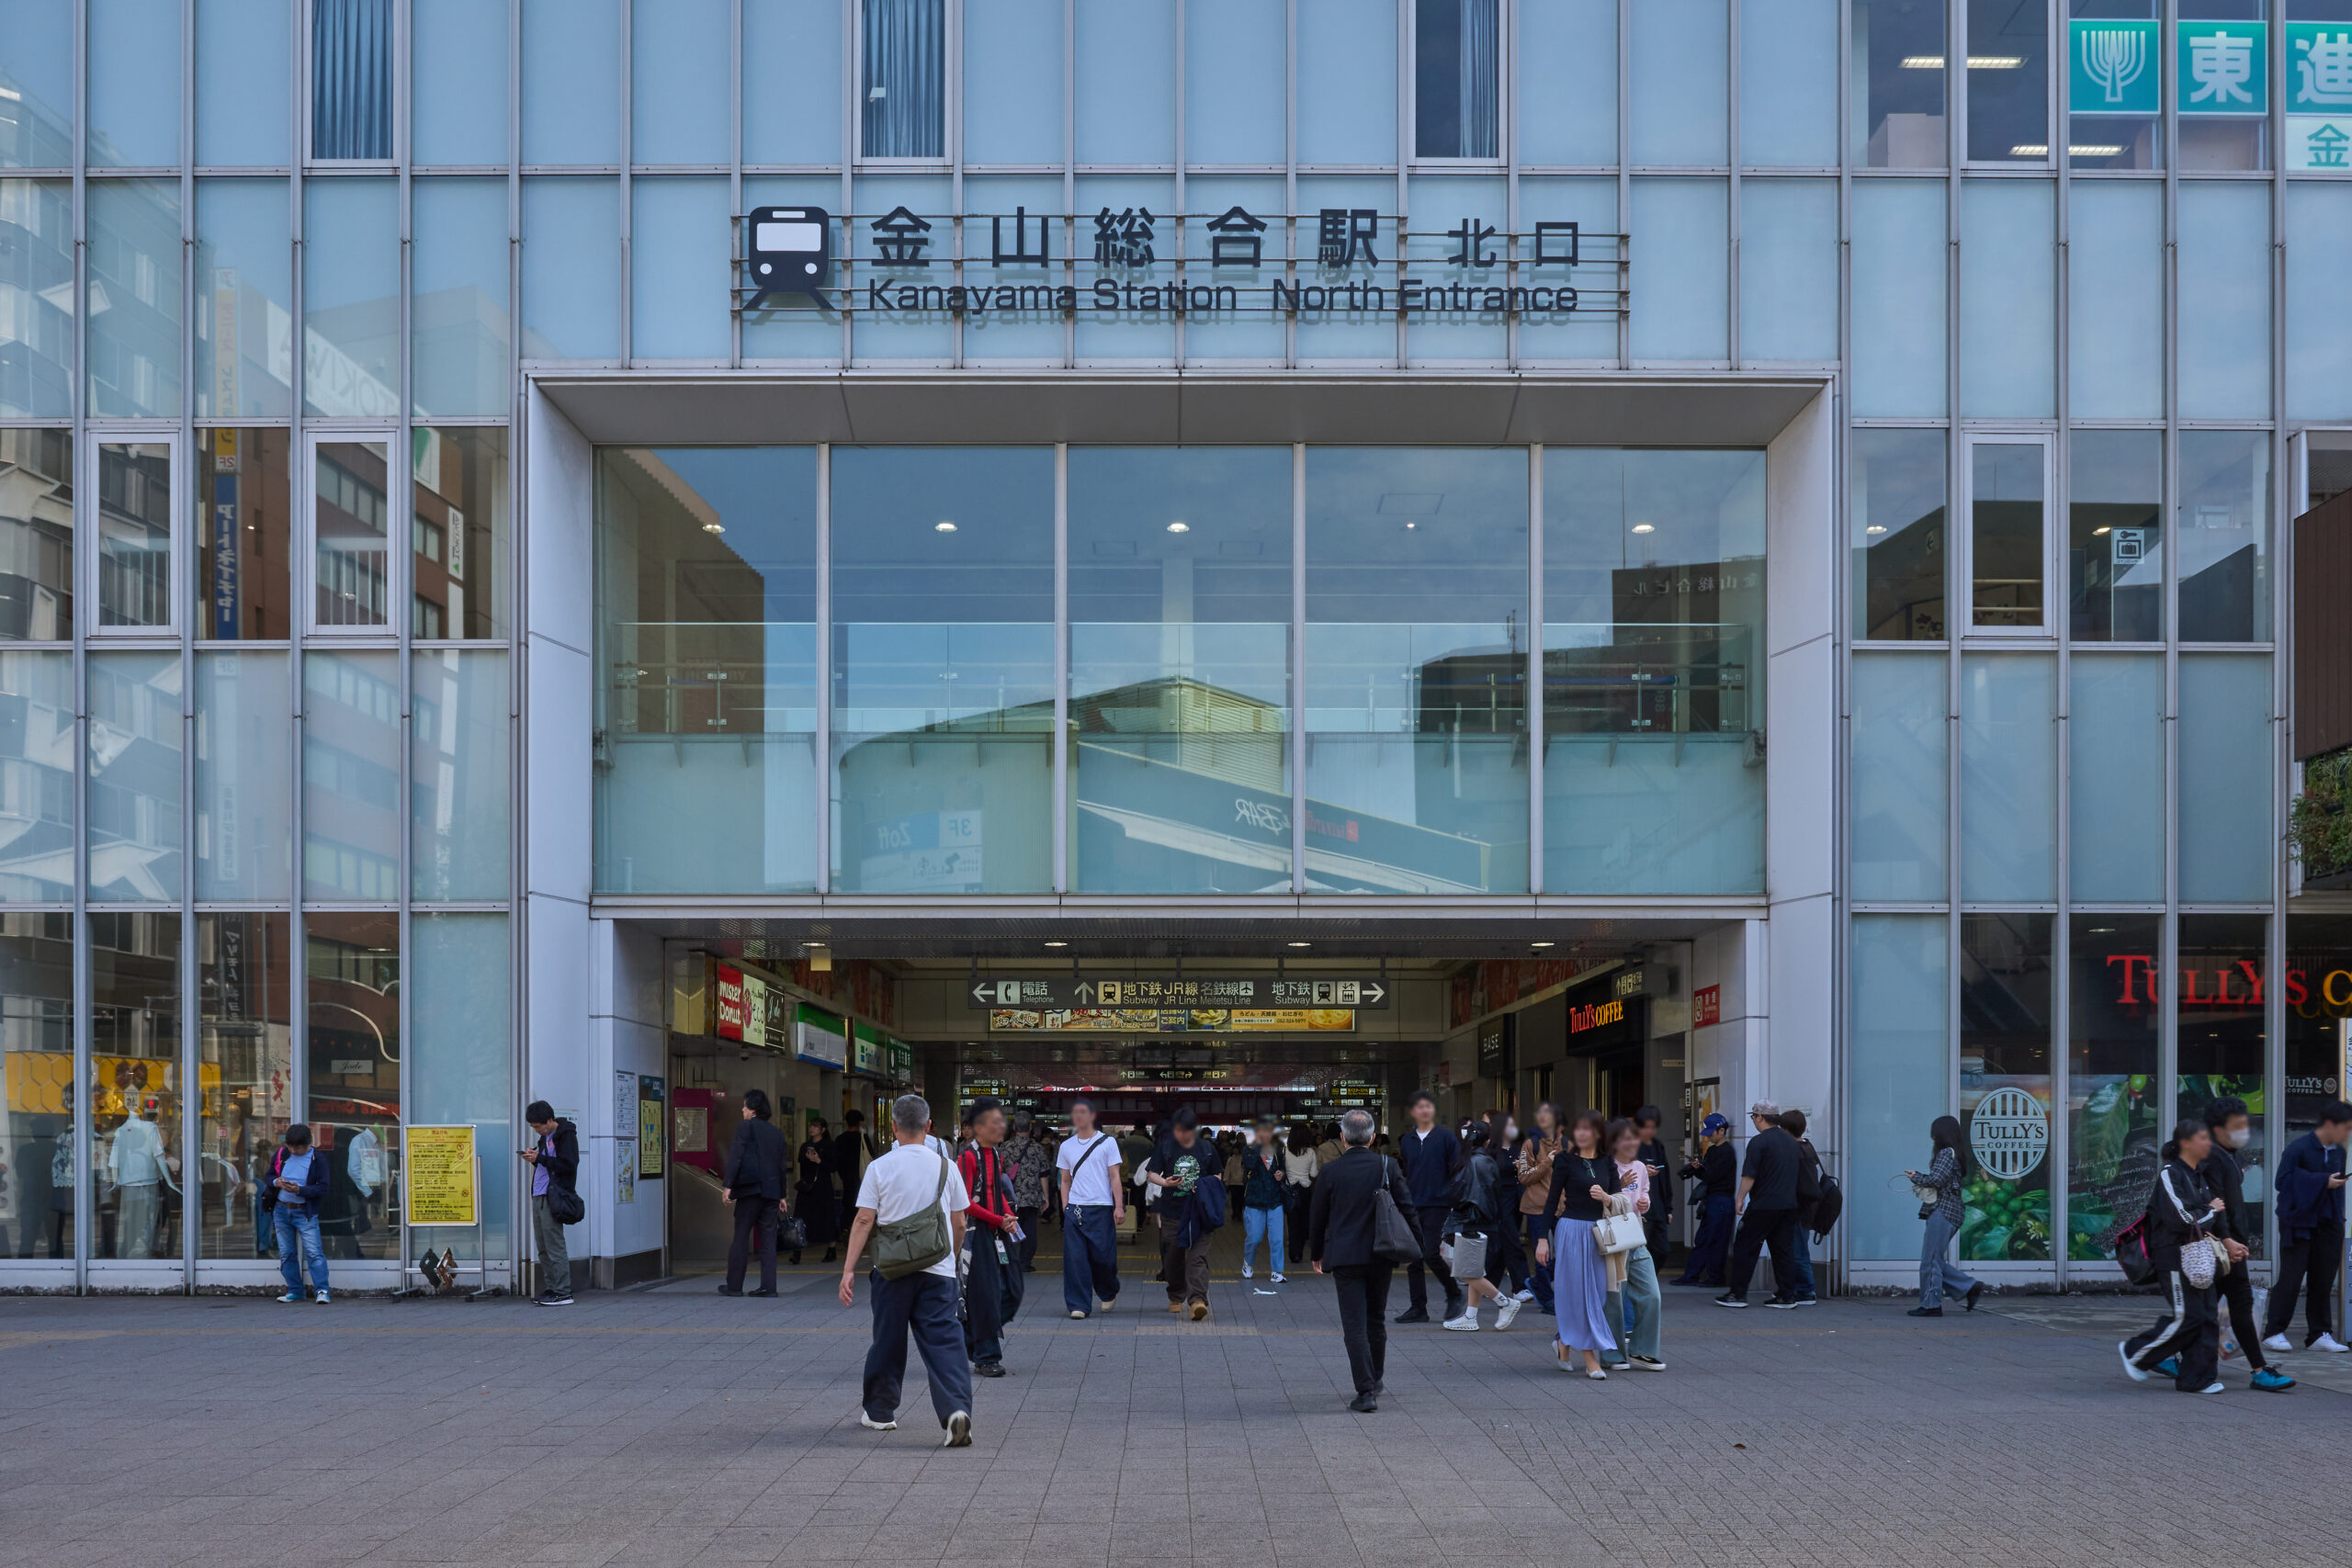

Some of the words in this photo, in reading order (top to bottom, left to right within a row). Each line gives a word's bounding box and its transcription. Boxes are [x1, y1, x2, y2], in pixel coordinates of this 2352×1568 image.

[2188, 30, 2352, 105] 東進
[2307, 123, 2350, 168] 金
[871, 206, 1379, 269] 金山総合駅
[1447, 217, 1580, 269] 北口
[870, 278, 1077, 315] Kanayama
[1093, 278, 1237, 312] Station
[1273, 278, 1385, 312] North
[1399, 278, 1577, 312] Entrance
[1022, 981, 1048, 996] 電話
[1123, 981, 1162, 996] 地下鉄
[1163, 981, 1199, 996] JR線
[1200, 981, 1240, 996] 名鉄線
[1272, 981, 1311, 996] 地下鉄
[1022, 995, 1055, 1004] Telephone
[1123, 996, 1159, 1006] Subway
[1163, 996, 1177, 1005] JR
[1178, 996, 1197, 1005] Line
[1200, 996, 1233, 1005] Meitetsu
[1234, 996, 1251, 1005] Line
[1274, 996, 1311, 1007] Subway
[1595, 998, 1624, 1027] COFFEE
[1483, 1033, 1499, 1053] BASE
[1974, 1122, 2044, 1139] TULLY'S
[2104, 1167, 2117, 1179] 70
